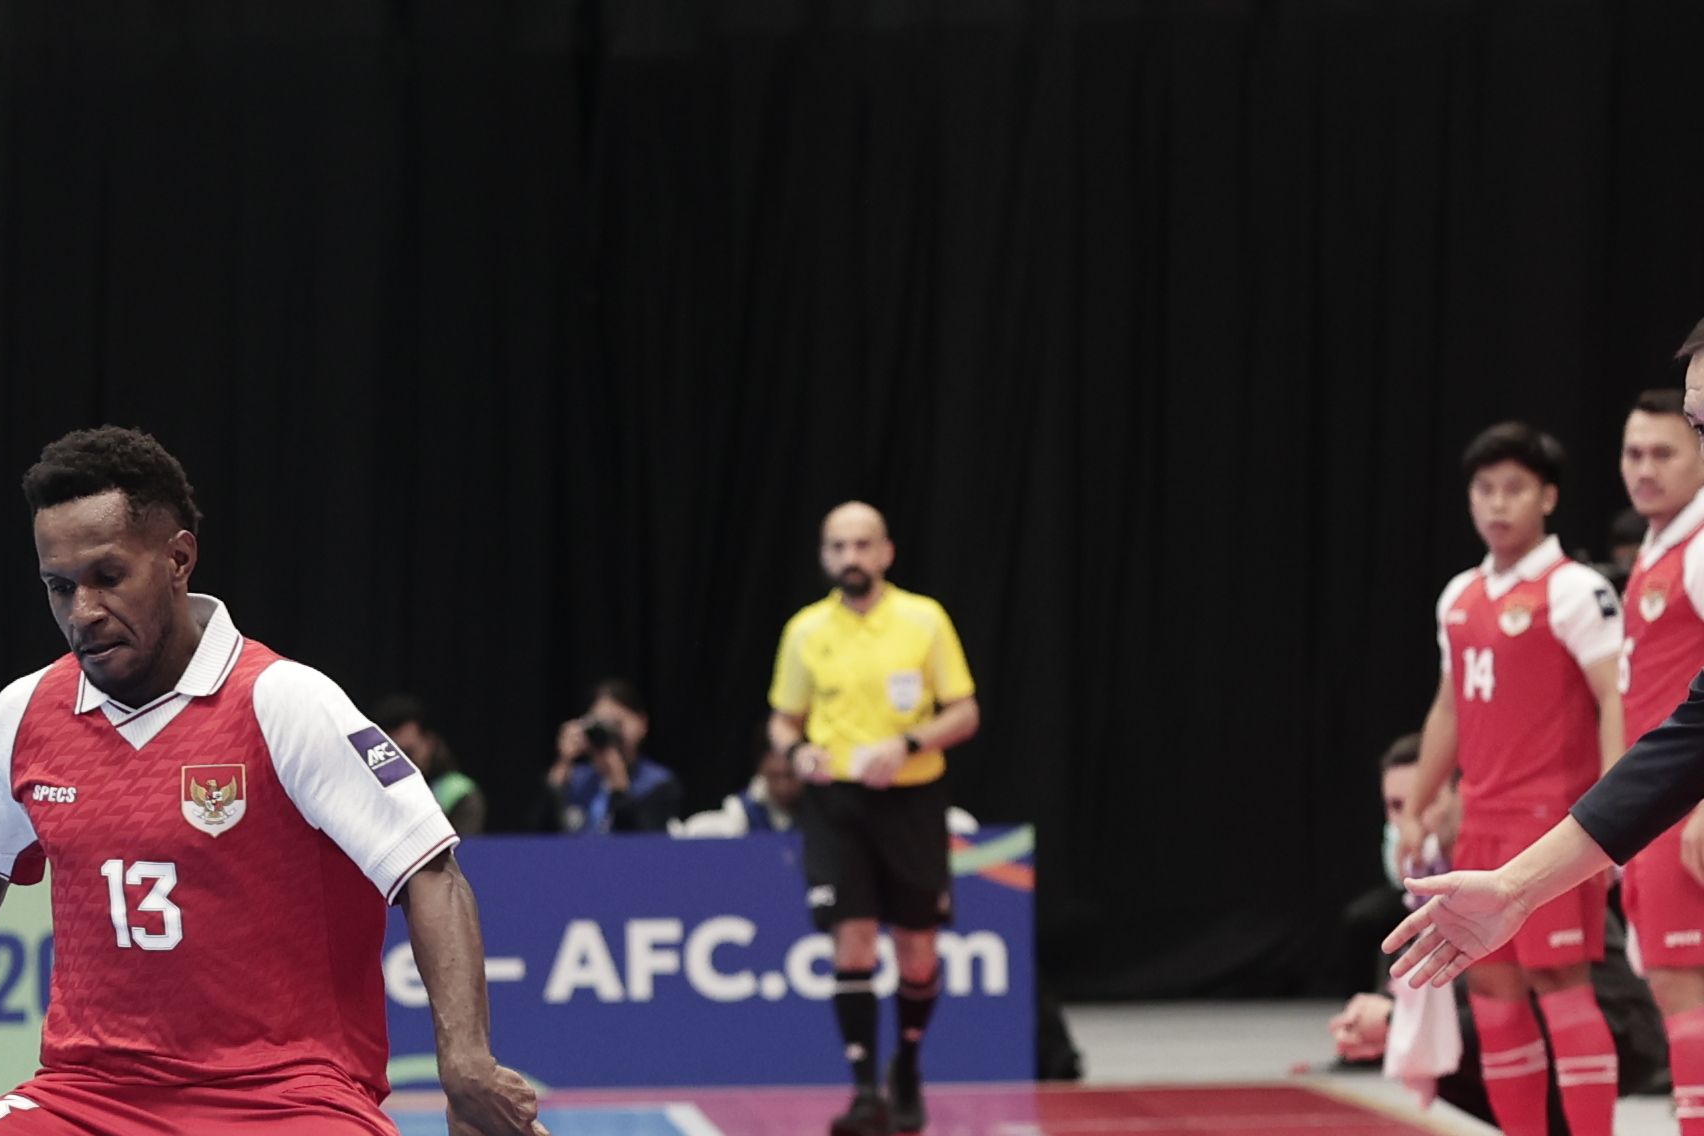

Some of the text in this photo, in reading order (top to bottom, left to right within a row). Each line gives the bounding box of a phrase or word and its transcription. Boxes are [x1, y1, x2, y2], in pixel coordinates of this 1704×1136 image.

[1463, 647, 1495, 702] 14
[367, 741, 397, 767] AFC
[32, 784, 77, 803] SPECS
[100, 859, 184, 951] 13
